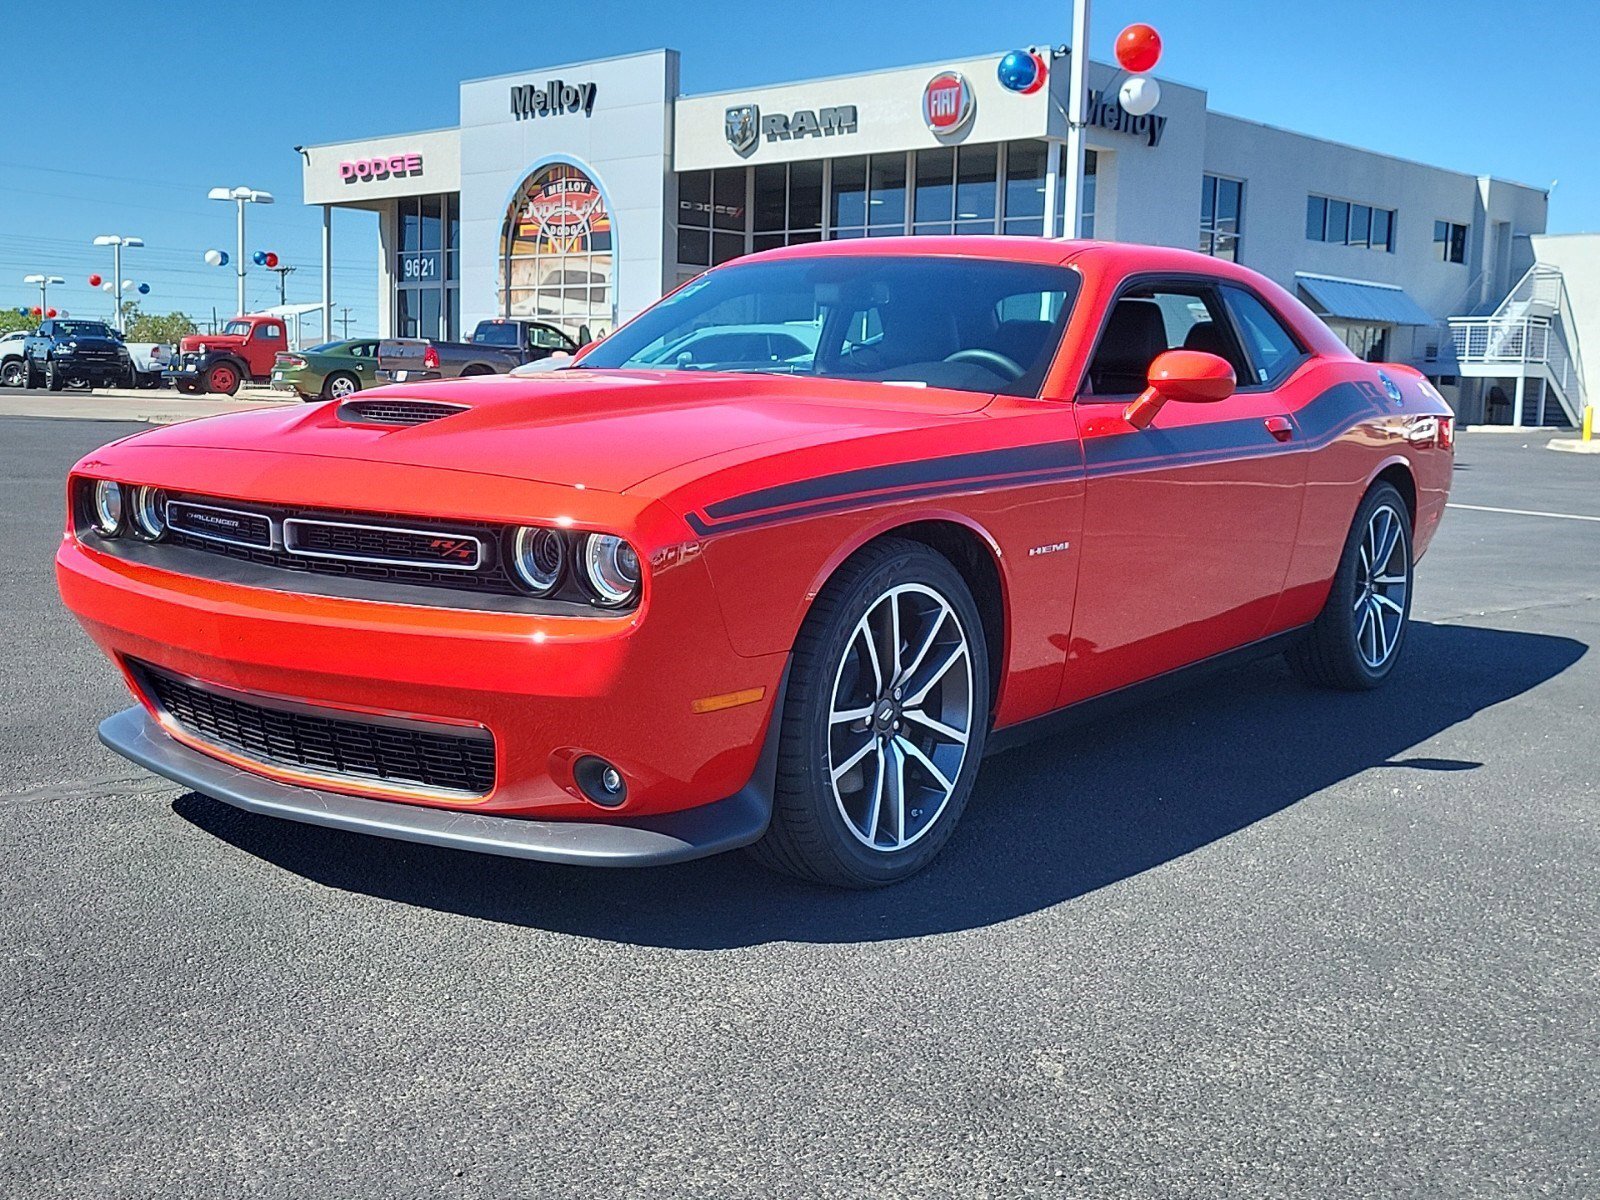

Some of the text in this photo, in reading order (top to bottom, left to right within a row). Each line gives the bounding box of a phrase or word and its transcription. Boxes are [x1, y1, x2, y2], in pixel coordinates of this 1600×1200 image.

[511, 80, 597, 119] Melloy
[931, 87, 959, 117] FIAT
[761, 105, 858, 141] RAM
[338, 153, 423, 182] DODGE
[548, 182, 588, 195] MELLOY
[404, 258, 435, 277] 9621
[430, 540, 476, 557] R/T
[1029, 541, 1070, 556] HEMI
